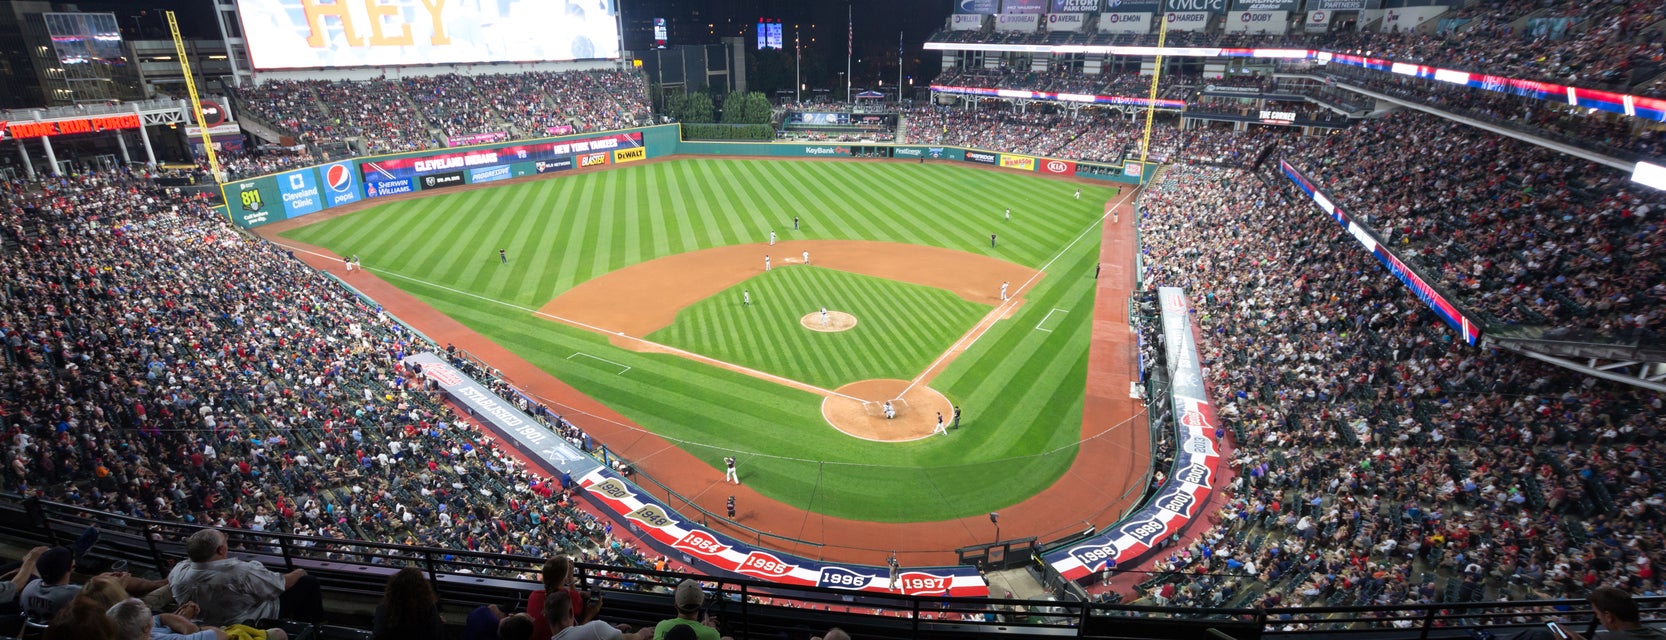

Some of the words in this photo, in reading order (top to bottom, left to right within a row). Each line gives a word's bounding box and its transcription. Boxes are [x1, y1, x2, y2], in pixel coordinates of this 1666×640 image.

[1058, 14, 1081, 23] AVERILL
[1176, 14, 1205, 22] HARDER
[1252, 13, 1272, 22] DOBY
[1259, 111, 1271, 119] THE
[1271, 111, 1296, 120] CORNER
[10, 122, 57, 138] HOME
[58, 119, 92, 134] RUN
[92, 114, 140, 131] PORCH
[414, 157, 464, 172] CLEVELAND
[465, 152, 498, 166] INDIANS
[553, 144, 570, 155] NEW
[570, 142, 590, 153] YORK
[590, 138, 618, 151] YANKEES
[472, 167, 509, 180] PROGRESSIVE
[1050, 162, 1063, 170] KIA
[377, 179, 408, 189] SHERWIN
[241, 189, 261, 205] 811
[282, 187, 318, 202] Cleveland
[334, 192, 354, 204] pepsi
[292, 198, 313, 209] Clinic
[459, 386, 521, 427] ESTABLISHED
[1194, 437, 1206, 453] 2013
[1184, 462, 1206, 484] 2007
[597, 481, 626, 498] 1920
[1165, 491, 1192, 512] 2001
[636, 507, 667, 526] 1948
[1130, 521, 1163, 539] 1999
[683, 534, 720, 553] 1954
[1078, 546, 1116, 563] 1998
[746, 555, 787, 575] 1995
[822, 572, 864, 586] 1996
[904, 578, 945, 589] 1997
